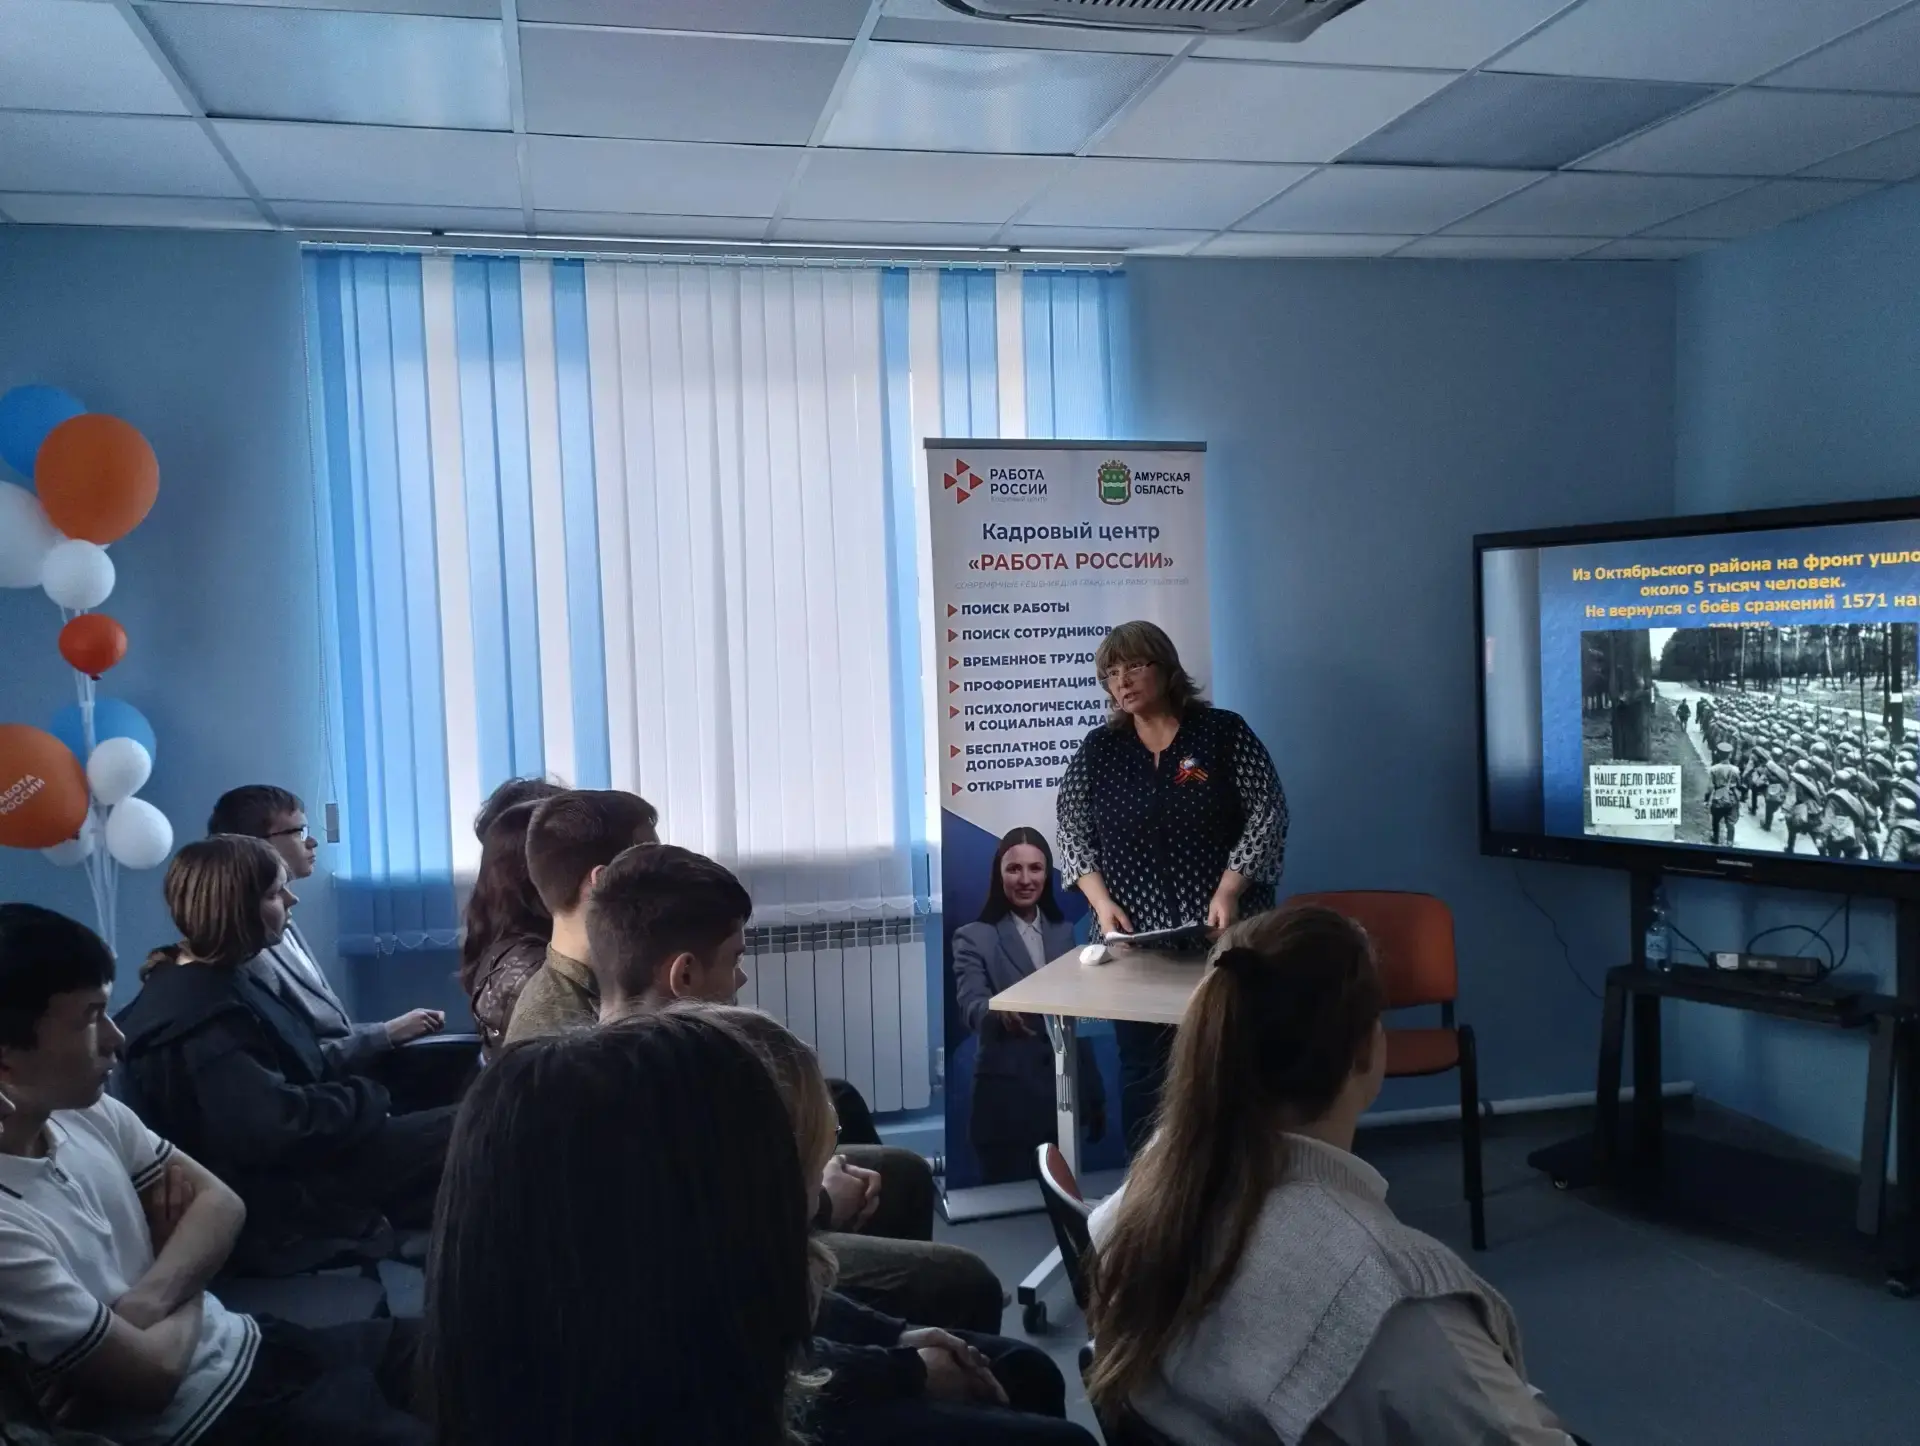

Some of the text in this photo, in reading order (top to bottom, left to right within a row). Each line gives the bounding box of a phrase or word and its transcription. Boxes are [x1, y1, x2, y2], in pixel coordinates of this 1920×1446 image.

[990, 468, 1044, 480] РАБОТА
[1134, 471, 1191, 482] АМУРСКАЯ
[990, 483, 1048, 495] РОССИИ
[1134, 484, 1184, 495] ОБЛАСТЬ
[982, 521, 1161, 544] Кадровый центр
[968, 552, 1174, 571] «РАБОТА РОССИИ»
[1572, 551, 1920, 581] Из Октябрьского района на фронт ушло
[1640, 576, 1846, 597] около 5 тысяч человек.
[961, 602, 1070, 615] ПОИСК РАБОТЫ
[1585, 593, 1920, 619] Не вернулся с боёв сражений 1571 на
[962, 629, 1010, 641] ПОИСК
[963, 652, 1097, 667] ВРЕМЕННОЕ ТРУДО
[963, 676, 1096, 692] ПРОФОРИЕНТАЦИЯ
[964, 700, 1100, 716] ПСИХОЛОГИЧЕСКАЯ
[965, 720, 975, 731] И
[978, 716, 1074, 731] СОЦИАЛЬНАЯ
[965, 740, 1057, 755] БЕСПЛАТНОЕ
[967, 778, 1043, 792] ОТКРЫТИЕ
[1594, 772, 1618, 786] НАШЕ
[1620, 772, 1643, 787] ДЕЛО
[1639, 796, 1670, 807] БУДЕТ
[1634, 807, 1678, 820] ЗА НАМИ!
